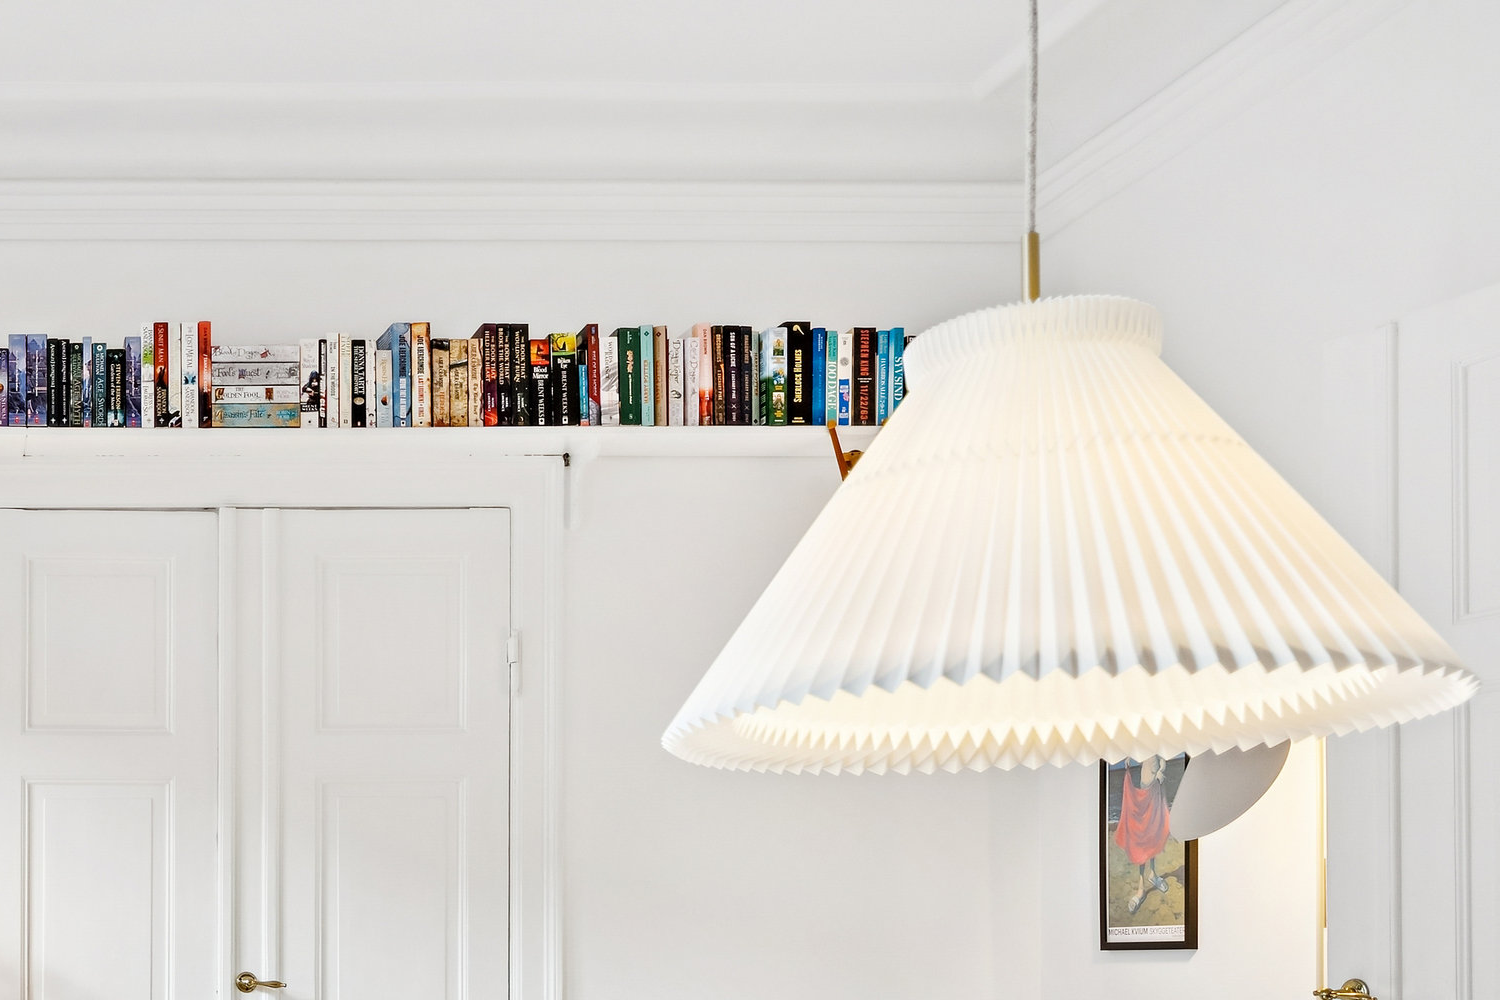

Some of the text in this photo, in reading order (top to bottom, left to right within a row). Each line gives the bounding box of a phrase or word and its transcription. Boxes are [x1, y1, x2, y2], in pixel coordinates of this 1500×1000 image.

[185, 334, 194, 369] LOST METAL
[860, 329, 869, 376] STEPHEN KING
[894, 356, 903, 376] SYV
[793, 349, 802, 403] SHERLOCK HOLMES
[828, 361, 836, 410] 100 DAGE
[894, 376, 903, 401] SIND
[1108, 928, 1130, 936] MICHAEL
